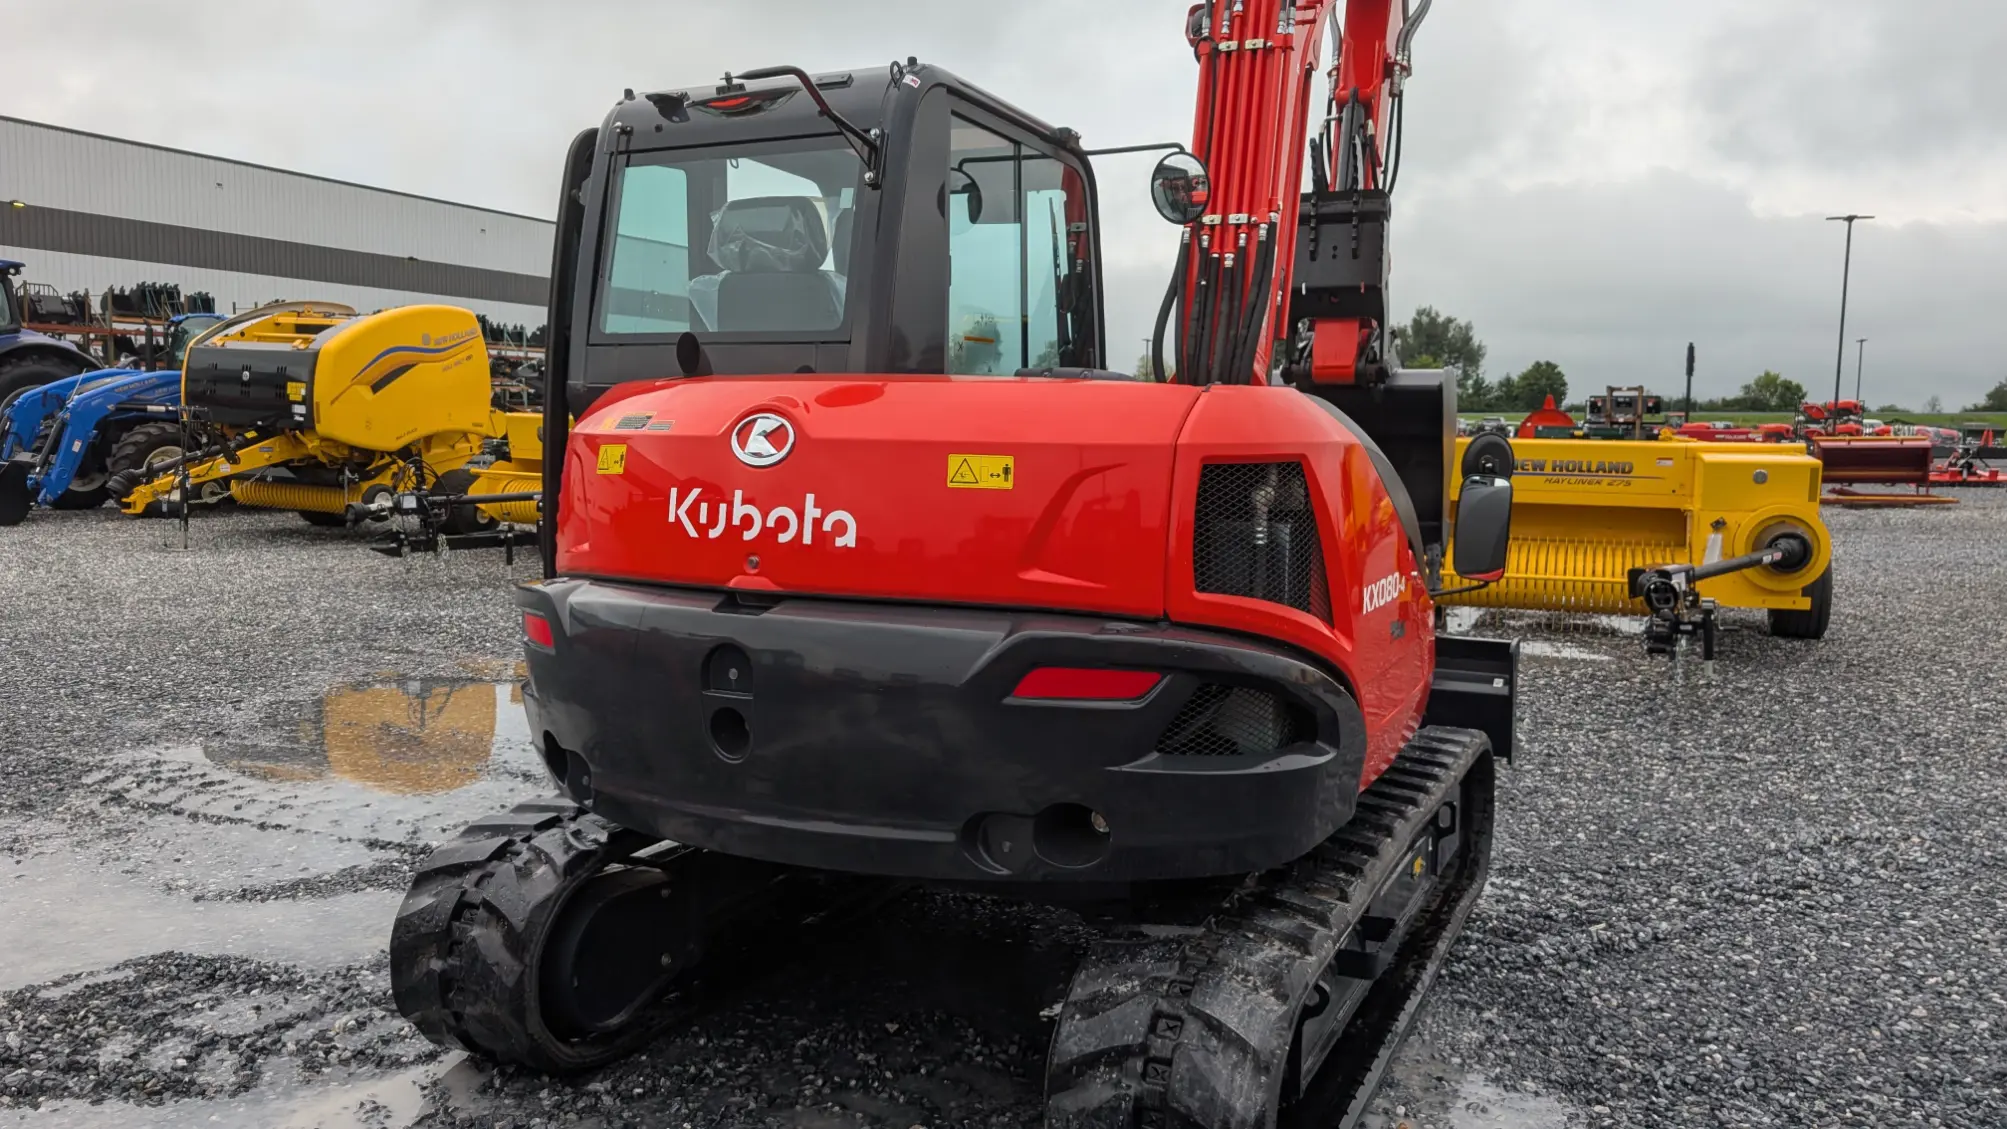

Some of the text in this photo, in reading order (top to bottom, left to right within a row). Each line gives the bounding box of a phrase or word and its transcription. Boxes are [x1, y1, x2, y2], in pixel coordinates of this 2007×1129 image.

[1544, 477, 1632, 487] HAYLINER 275
[1552, 459, 1634, 475] HOLLAND
[668, 487, 857, 548] Kubota
[1363, 571, 1406, 616] KX080-4
